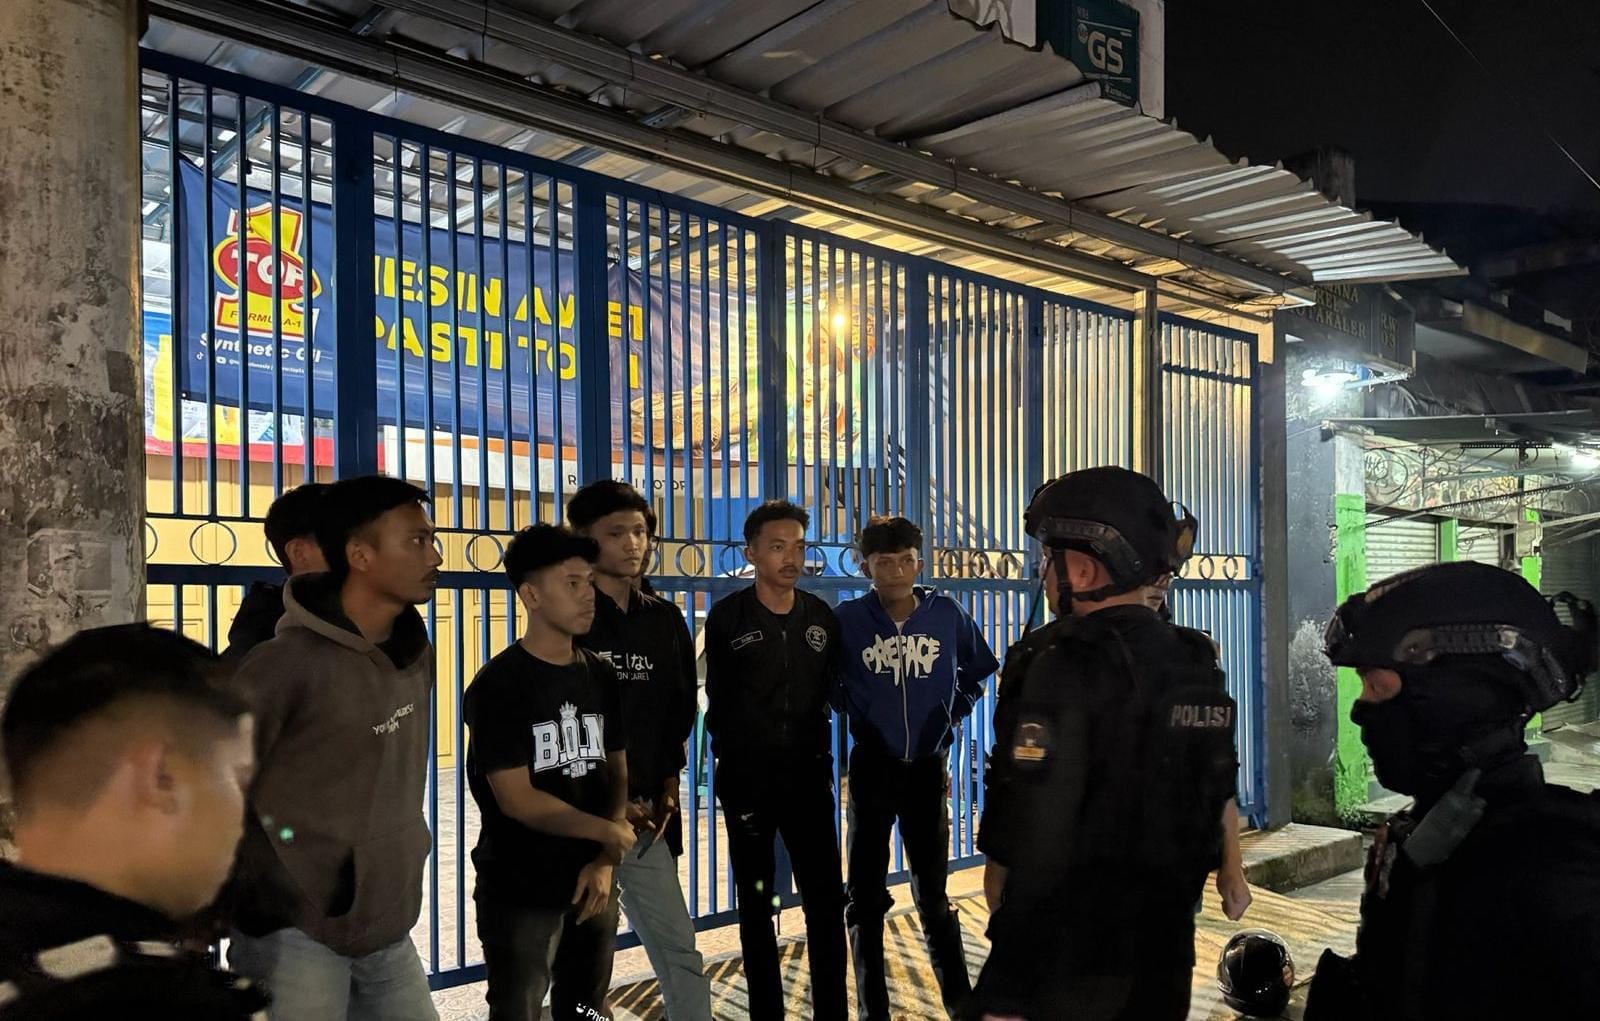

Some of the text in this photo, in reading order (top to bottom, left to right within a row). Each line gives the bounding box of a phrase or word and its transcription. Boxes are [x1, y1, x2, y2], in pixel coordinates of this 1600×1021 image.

[1088, 31, 1123, 75] GS
[230, 310, 302, 329] FRMA-1
[514, 286, 645, 341] AET
[199, 332, 321, 363] Syntetc Ol
[375, 316, 503, 370] ASTI
[517, 336, 577, 381] TO
[862, 634, 940, 686] PREFACE
[1171, 705, 1232, 727] POLISI
